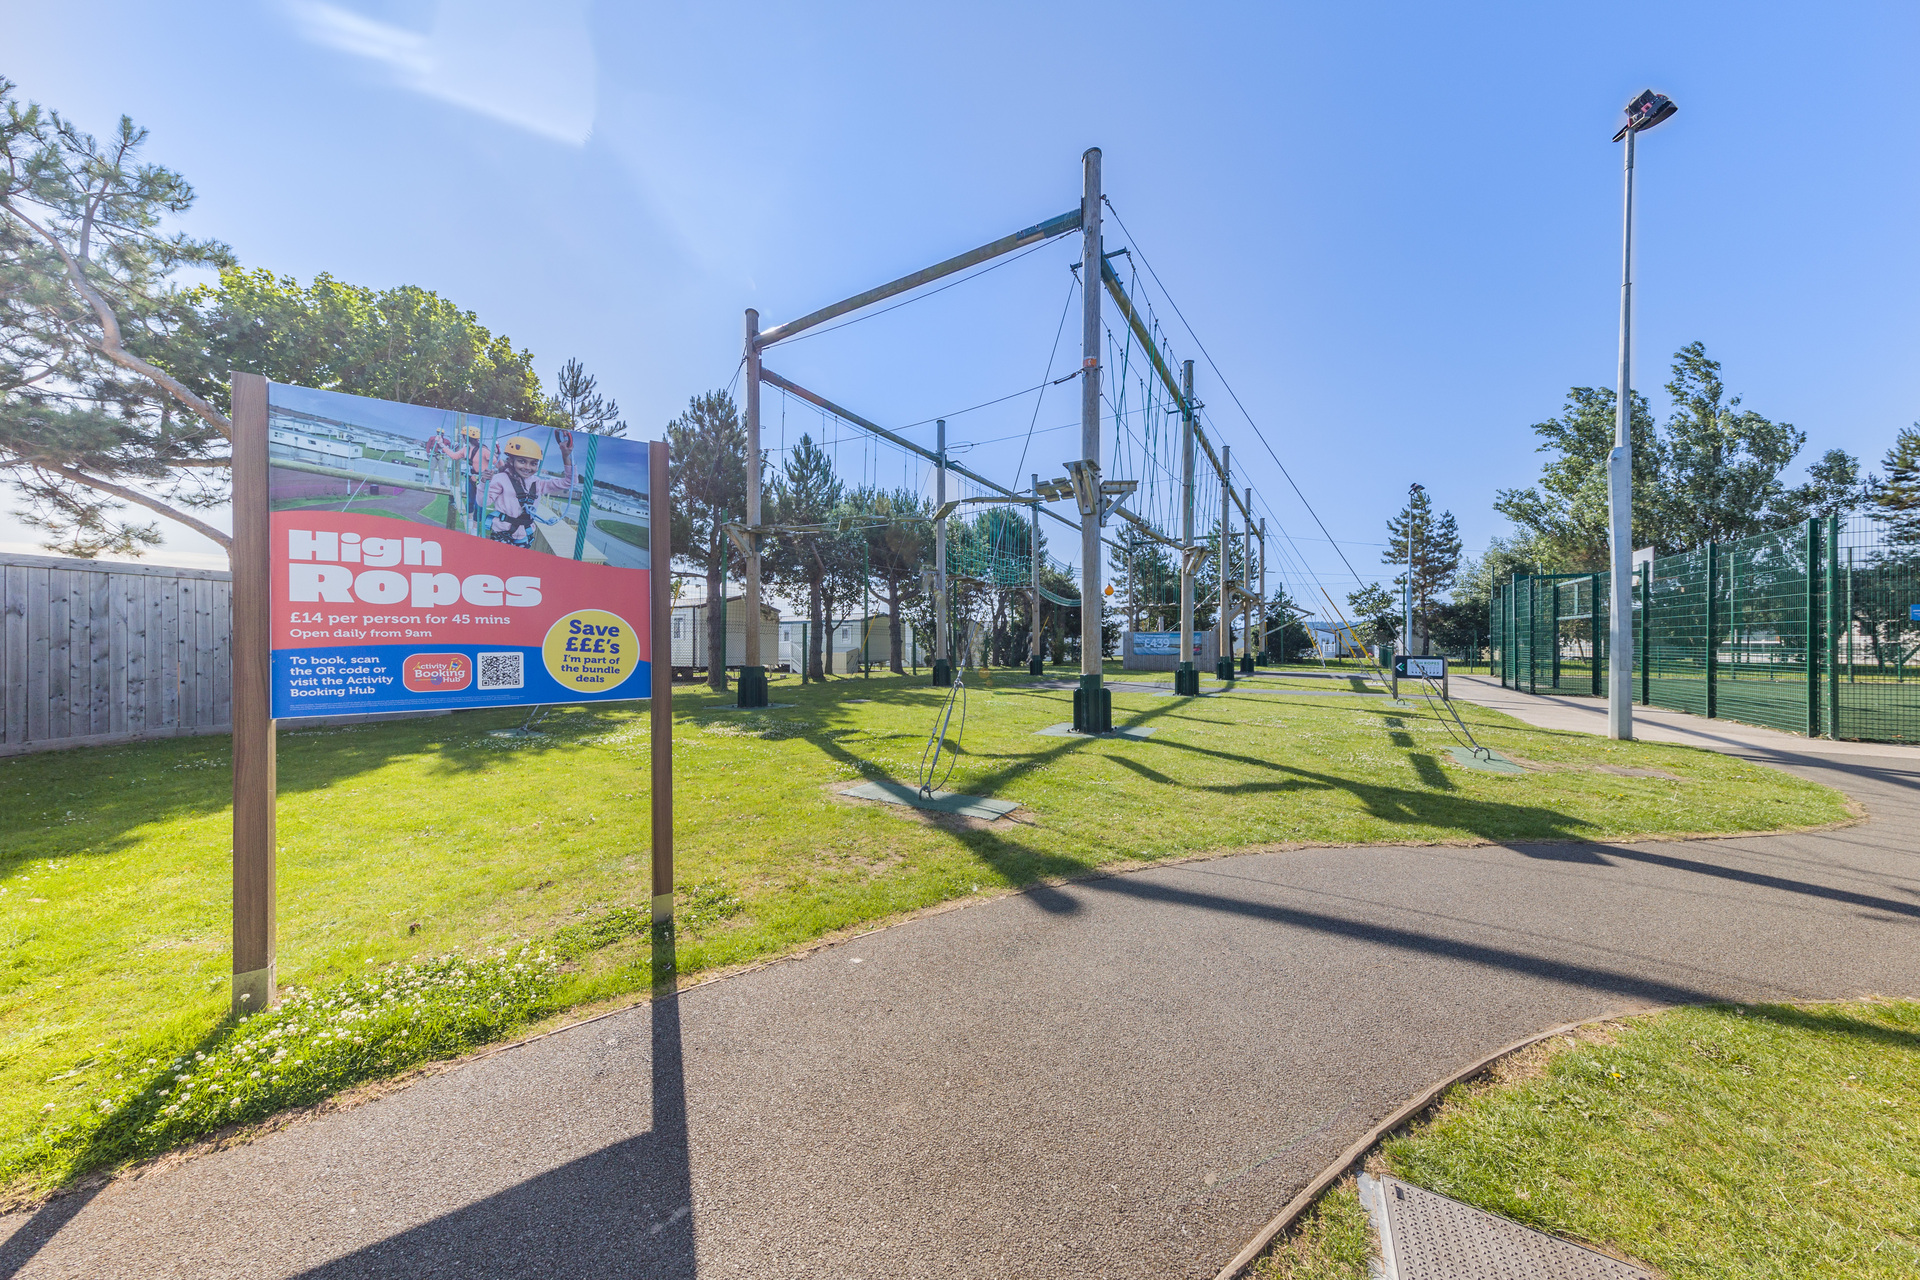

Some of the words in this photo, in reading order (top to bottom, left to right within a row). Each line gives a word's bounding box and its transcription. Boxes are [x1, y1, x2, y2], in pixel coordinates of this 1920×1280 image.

[288, 529, 443, 567] High
[288, 563, 543, 608] Ropes
[290, 611, 323, 624] £14
[328, 614, 358, 626] per
[362, 614, 421, 627] person
[425, 613, 448, 625] for
[451, 614, 471, 625] 45
[474, 614, 511, 625] mins
[568, 618, 620, 637] Save
[289, 628, 330, 640] Open
[333, 628, 367, 640] daily
[370, 628, 402, 638] from
[404, 628, 433, 638] 9am
[564, 636, 620, 655] £££'s
[1144, 638, 1170, 648] £439
[289, 656, 308, 665] To
[310, 656, 348, 665] book,
[350, 656, 380, 664] scan
[563, 654, 581, 664] I'm
[583, 656, 607, 665] part
[608, 657, 621, 665] of
[289, 667, 313, 676] the
[315, 666, 336, 675] QR
[338, 665, 370, 675] code
[372, 666, 388, 674] or
[412, 661, 448, 670] Activity
[560, 664, 580, 673] the
[581, 665, 621, 675] bundle
[414, 668, 466, 679] Booking
[575, 674, 605, 683] deals
[289, 677, 319, 687] visit
[321, 676, 344, 685] the
[345, 675, 395, 686] Activity
[442, 676, 461, 684] Hub
[289, 687, 346, 698] Booking
[348, 685, 376, 695] Hub
